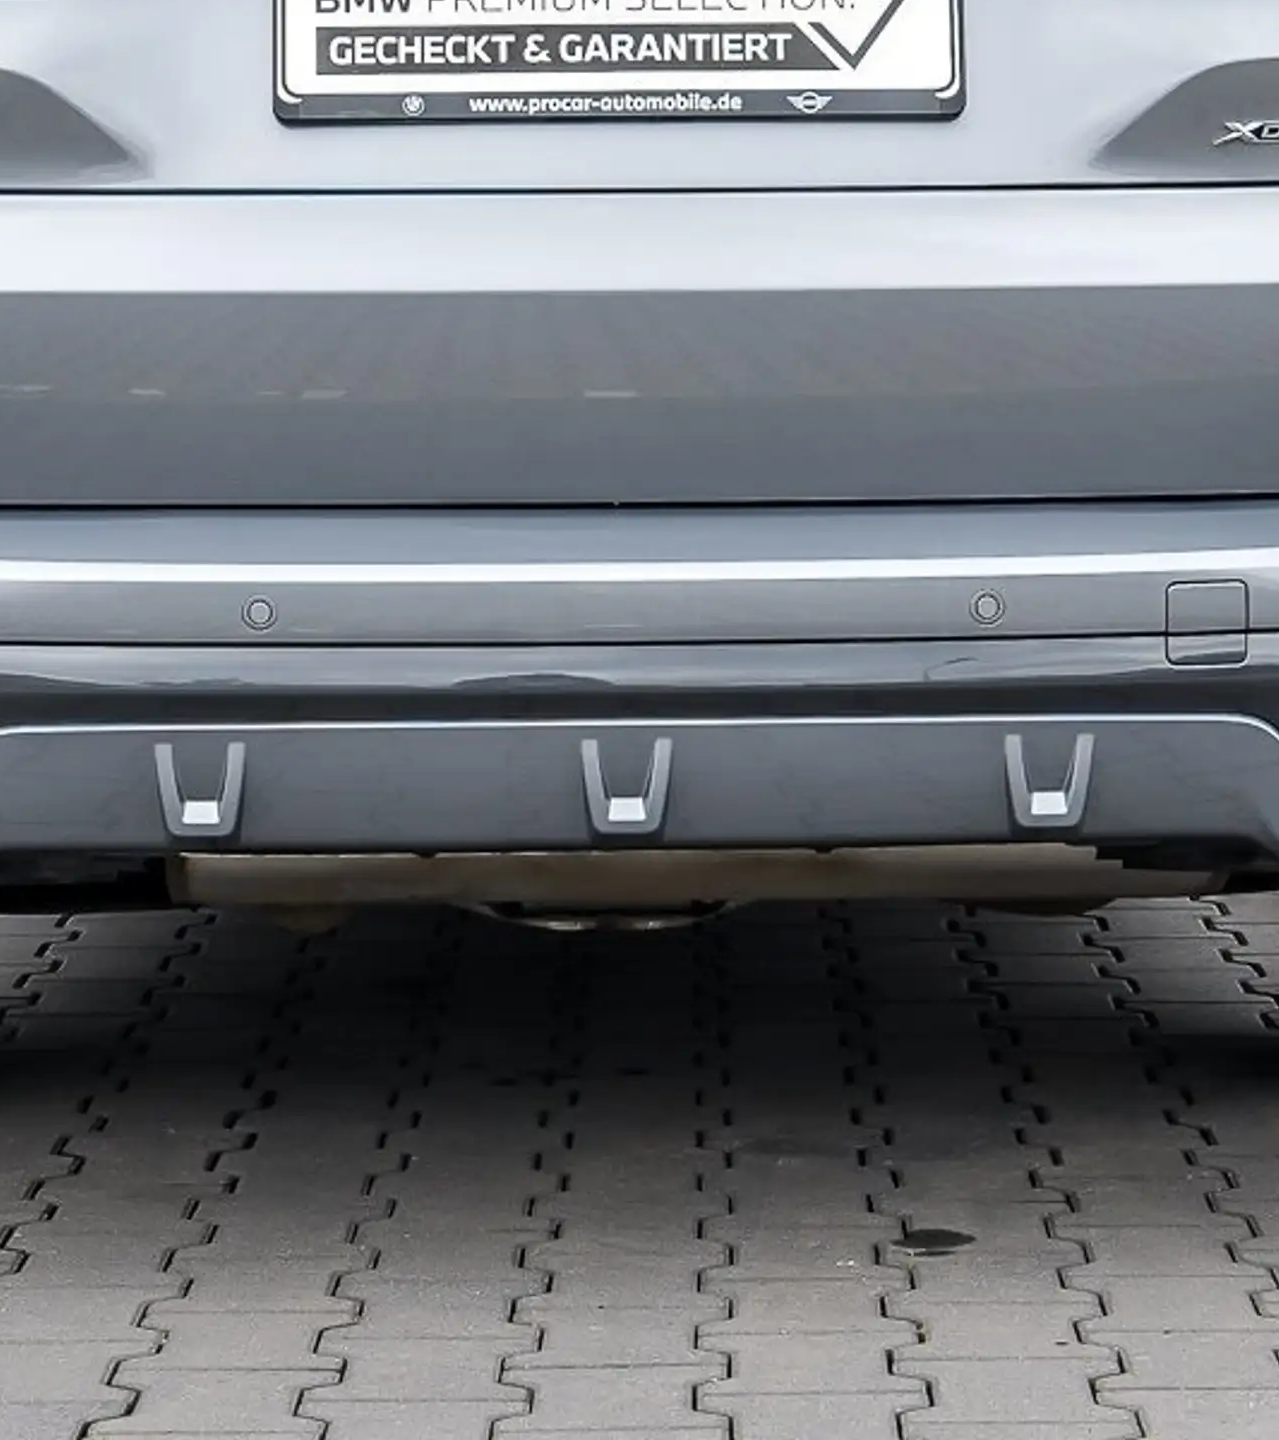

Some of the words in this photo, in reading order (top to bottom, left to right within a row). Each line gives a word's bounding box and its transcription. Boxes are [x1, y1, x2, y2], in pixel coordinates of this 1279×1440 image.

[328, 35, 516, 65] GECHECKT
[523, 34, 551, 62] &
[559, 33, 793, 62] GARANTIERT
[468, 94, 743, 116] www.procar-automobile.de
